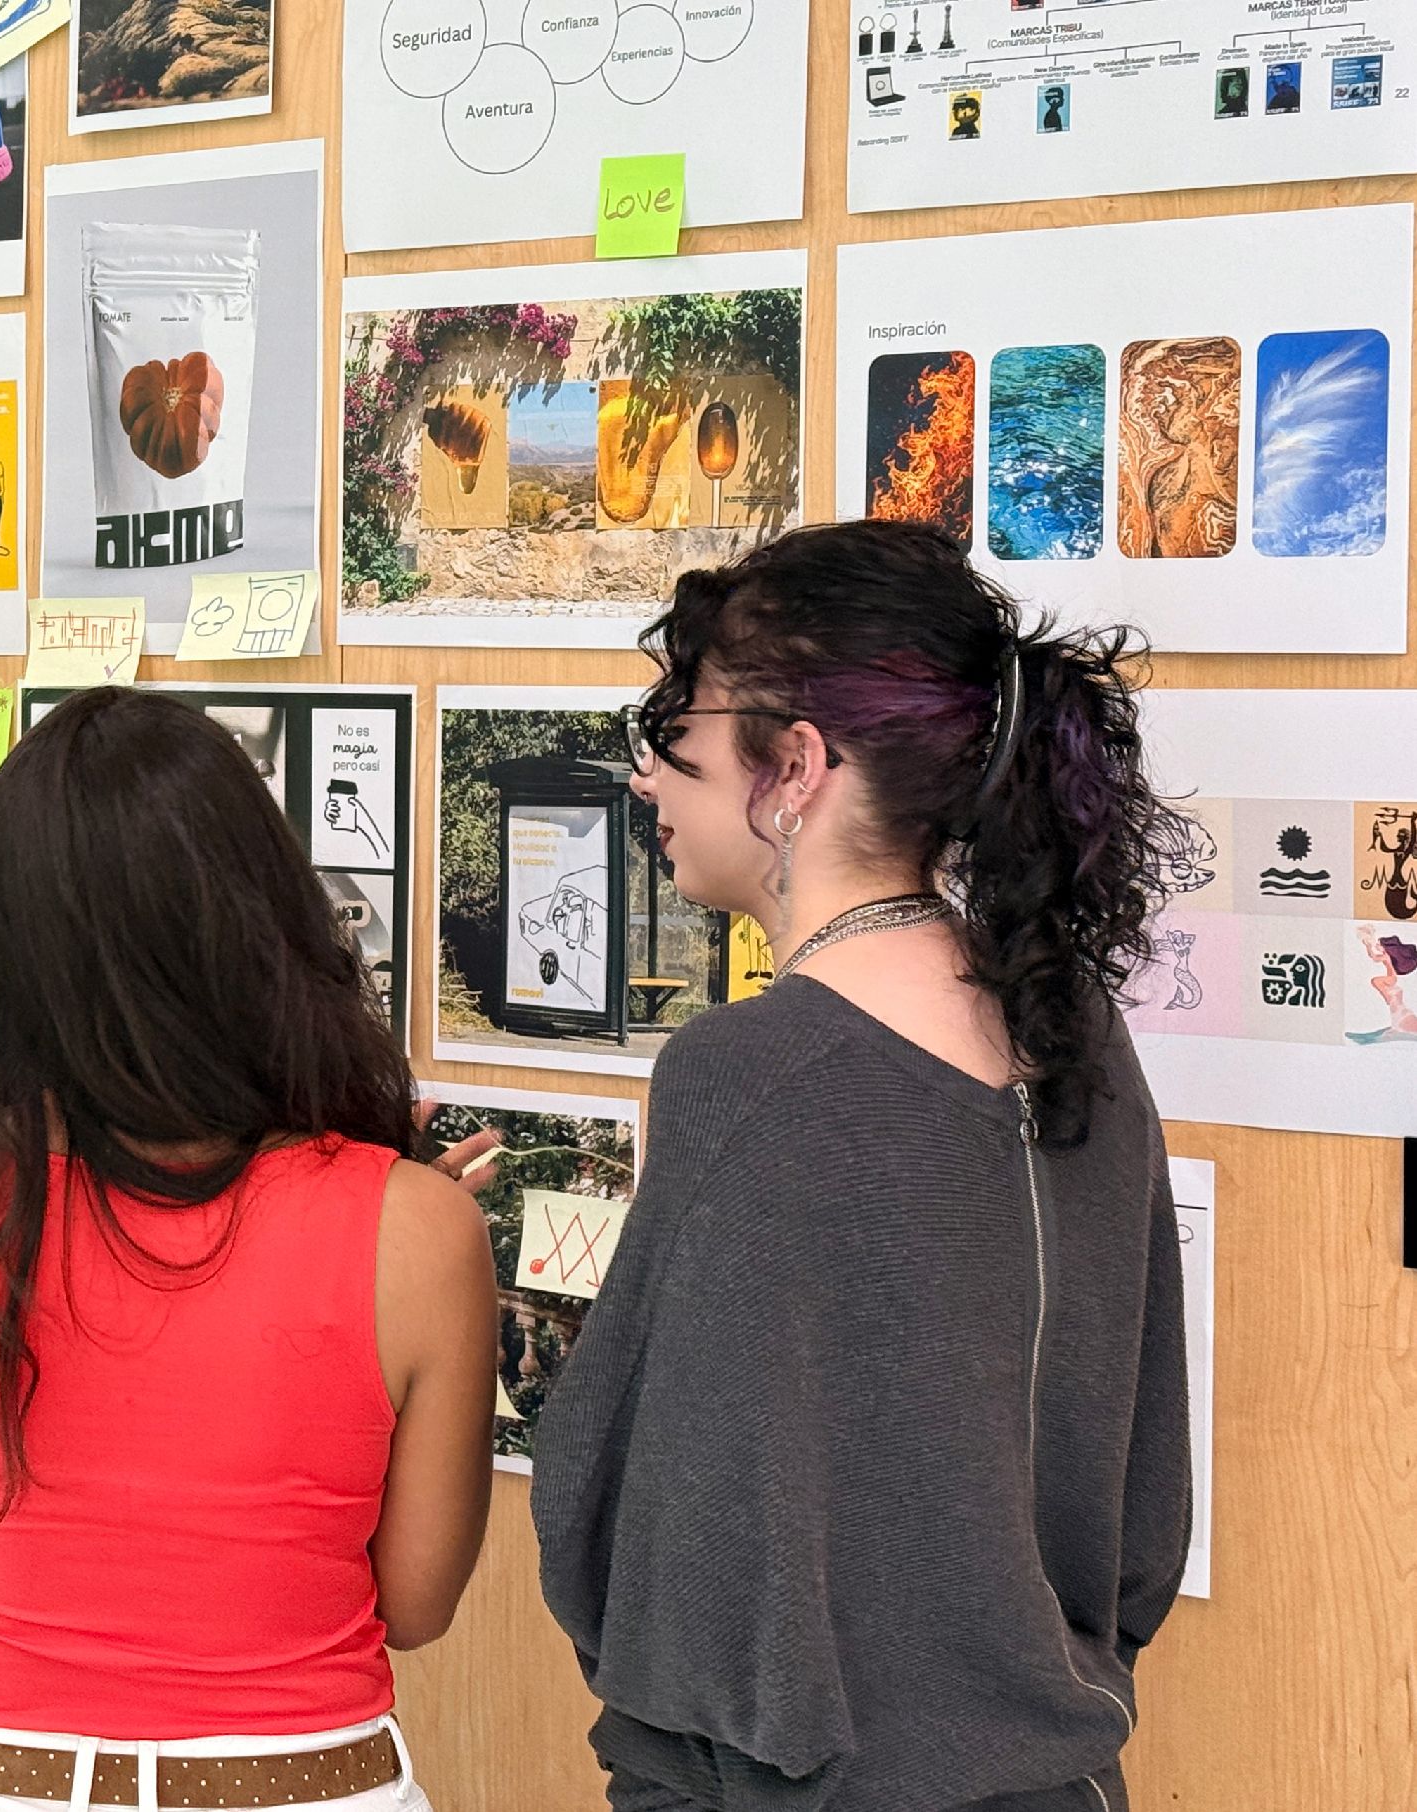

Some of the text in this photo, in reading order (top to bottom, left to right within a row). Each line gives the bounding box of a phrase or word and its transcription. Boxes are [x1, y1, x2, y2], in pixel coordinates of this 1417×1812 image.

[686, 5, 741, 21] Innovación
[541, 16, 600, 33] Confianza
[1010, 23, 1083, 38] MARCAS TRIBU
[392, 24, 472, 51] Seguridad
[987, 35, 1052, 49] (Comunidades
[611, 46, 674, 63] Experiencias
[1394, 88, 1410, 99] 22
[465, 101, 534, 119] Aventura
[99, 312, 132, 323] TOMATE
[867, 320, 947, 341] Inspiración
[338, 724, 370, 737] No es
[333, 743, 378, 760] magia
[333, 761, 358, 773] pero
